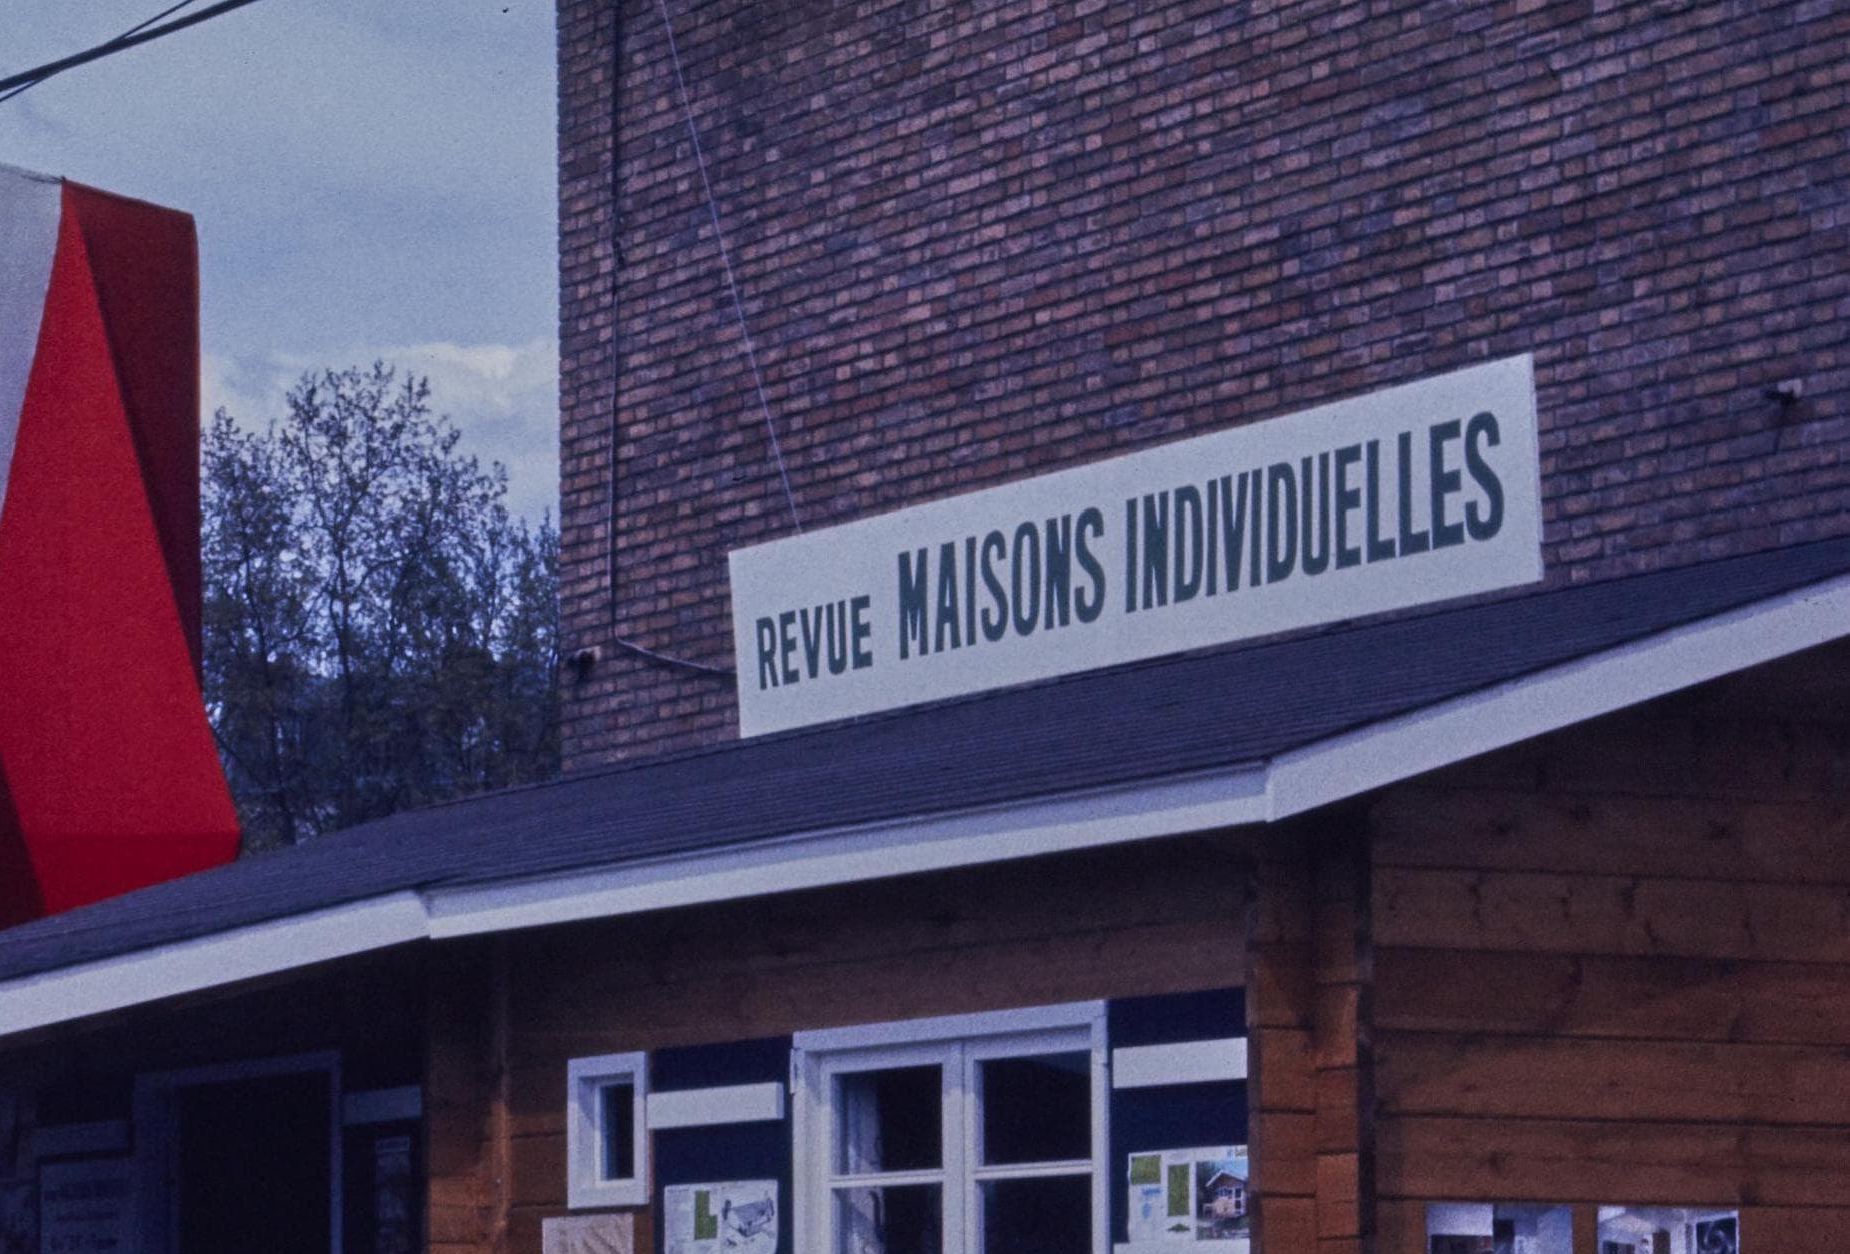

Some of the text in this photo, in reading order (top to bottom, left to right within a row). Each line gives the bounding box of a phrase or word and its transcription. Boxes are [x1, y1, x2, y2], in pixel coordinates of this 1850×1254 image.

[755, 410, 1505, 691] REVUE MAISONS INDIVIDUELLES
